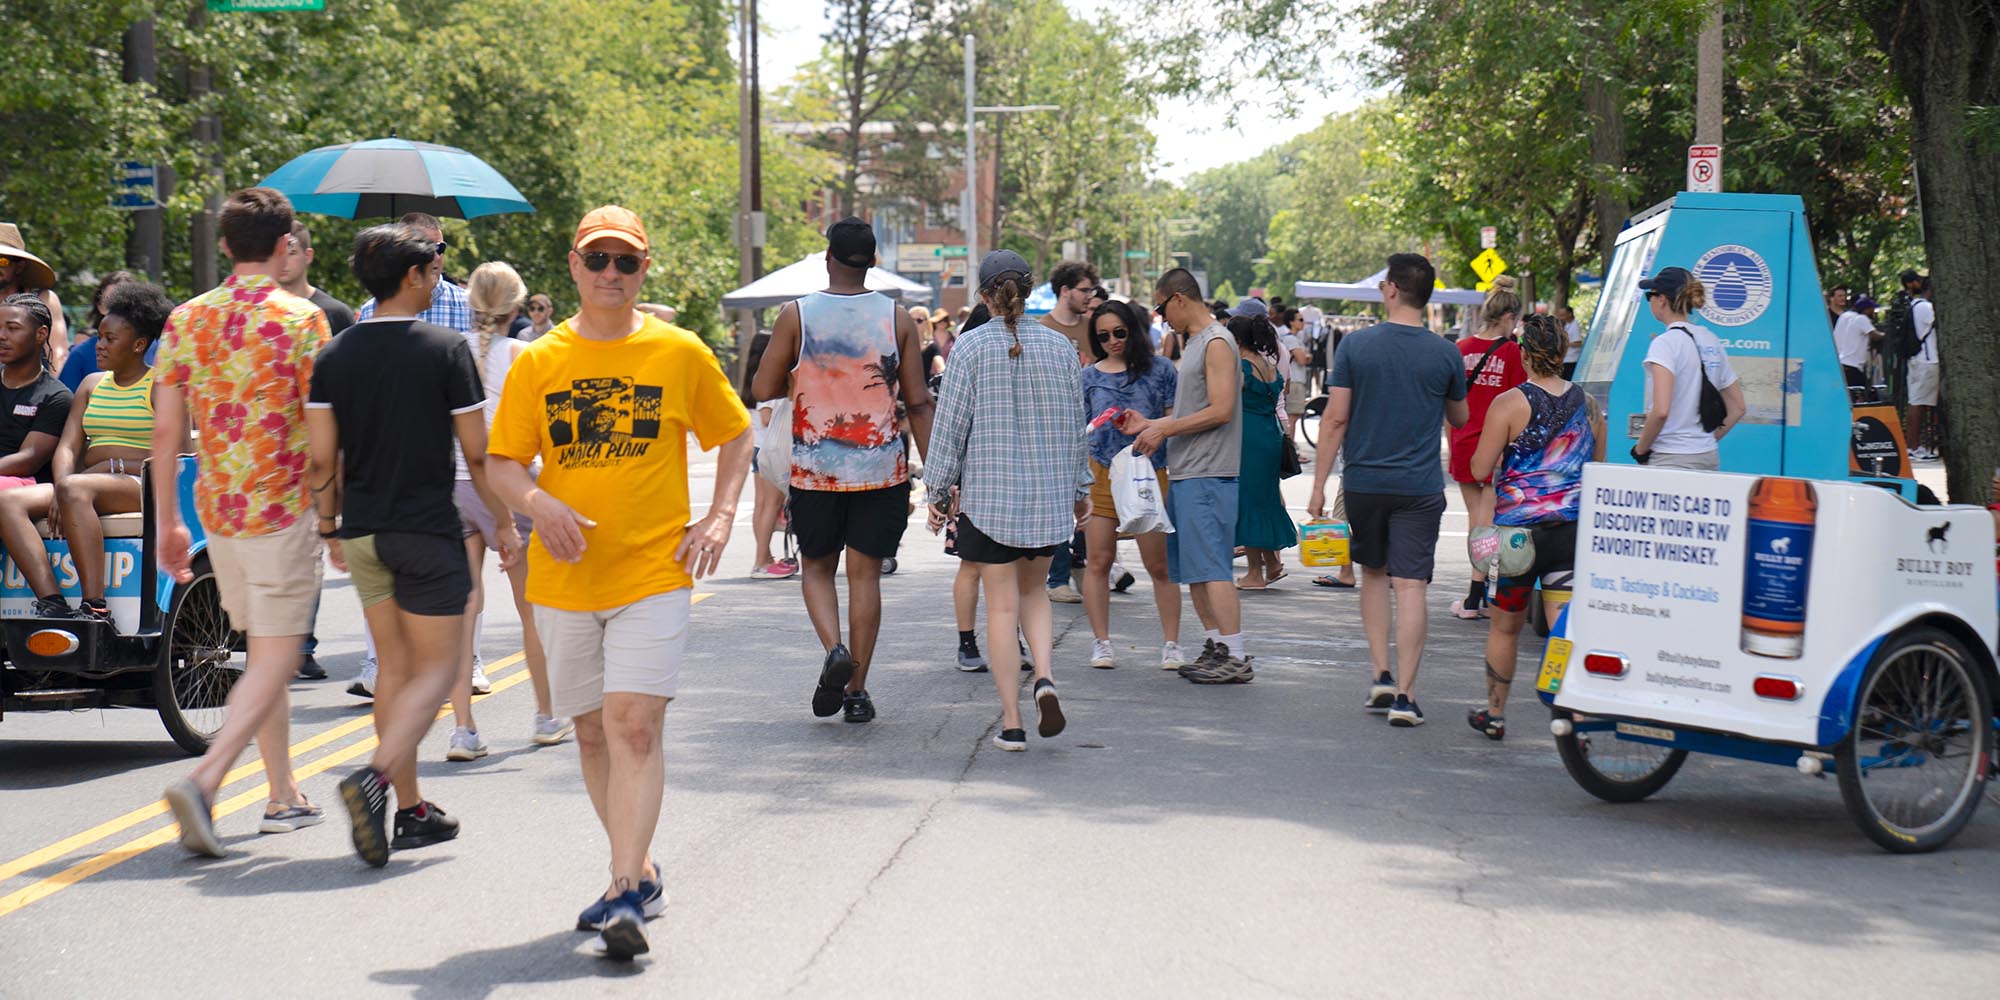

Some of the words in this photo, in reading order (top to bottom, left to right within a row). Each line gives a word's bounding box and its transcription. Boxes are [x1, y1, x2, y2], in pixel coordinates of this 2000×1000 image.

[605, 442, 651, 459] PLAIN
[1595, 487, 1649, 509] FOLLOW
[1651, 492, 1681, 512] THIS
[1684, 496, 1711, 515] CAB
[1715, 498, 1731, 517] TO
[1593, 511, 1656, 535] DISCOVER
[1660, 518, 1694, 538] YOUR
[1697, 522, 1731, 541] NEW
[1592, 535, 1651, 559] FAVORITE
[1654, 541, 1719, 566] WHISKEY.
[1897, 558, 1941, 574] BULLY
[1946, 561, 1973, 576] BOY
[1590, 572, 1617, 592] Tours,
[1620, 576, 1661, 599] Tastings
[1662, 582, 1670, 597] &
[1672, 582, 1720, 603] Cocktails
[1545, 660, 1562, 676] 54
